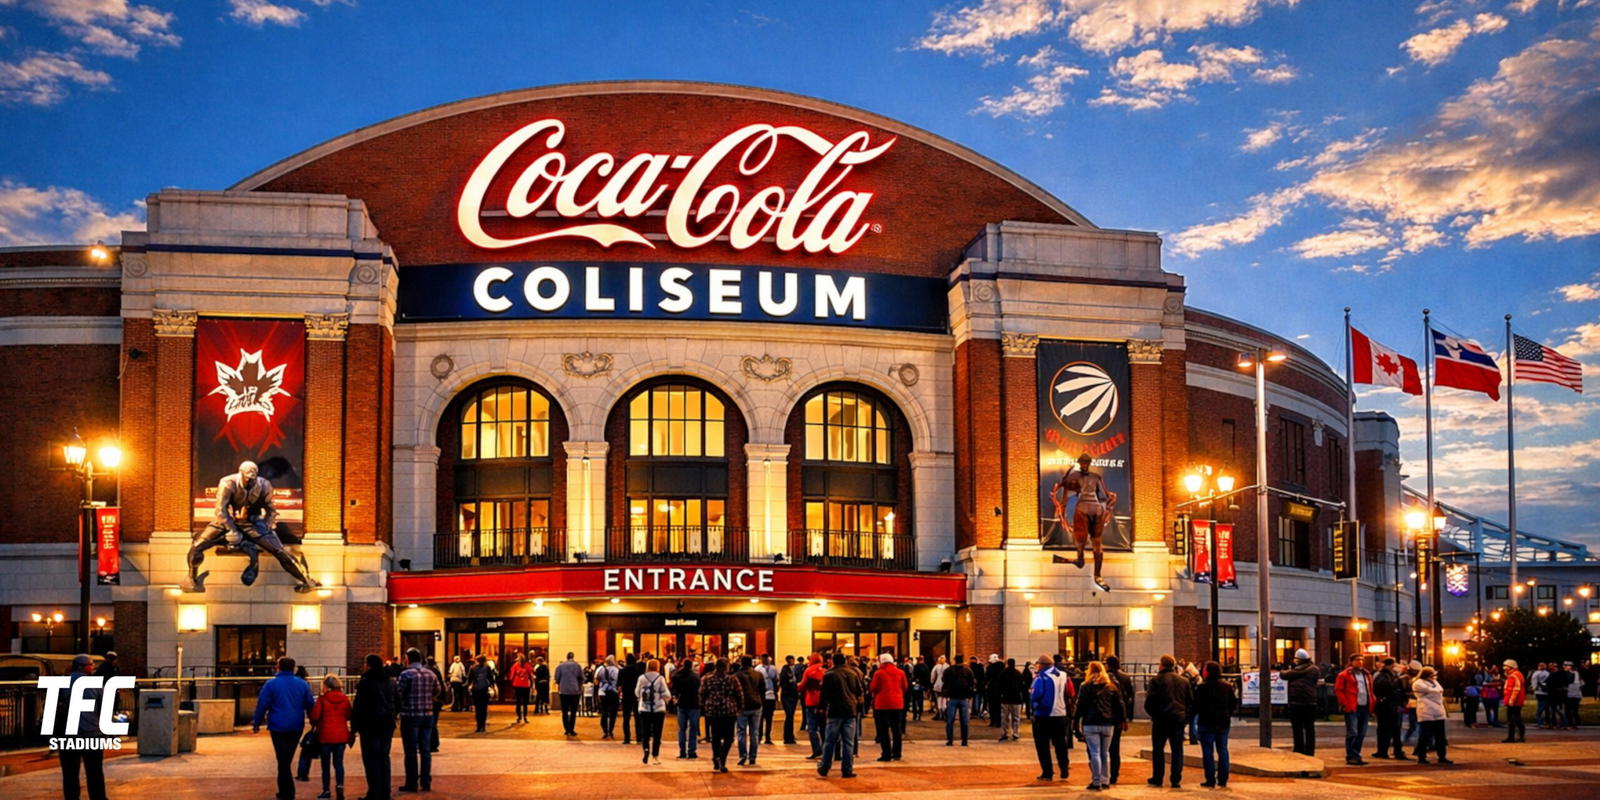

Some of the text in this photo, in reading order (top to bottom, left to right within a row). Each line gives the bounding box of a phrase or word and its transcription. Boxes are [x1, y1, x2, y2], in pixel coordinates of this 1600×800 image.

[457, 118, 897, 254] Coca-Cola
[472, 266, 867, 320] COLISEUM
[603, 568, 775, 593] ENTRANCE
